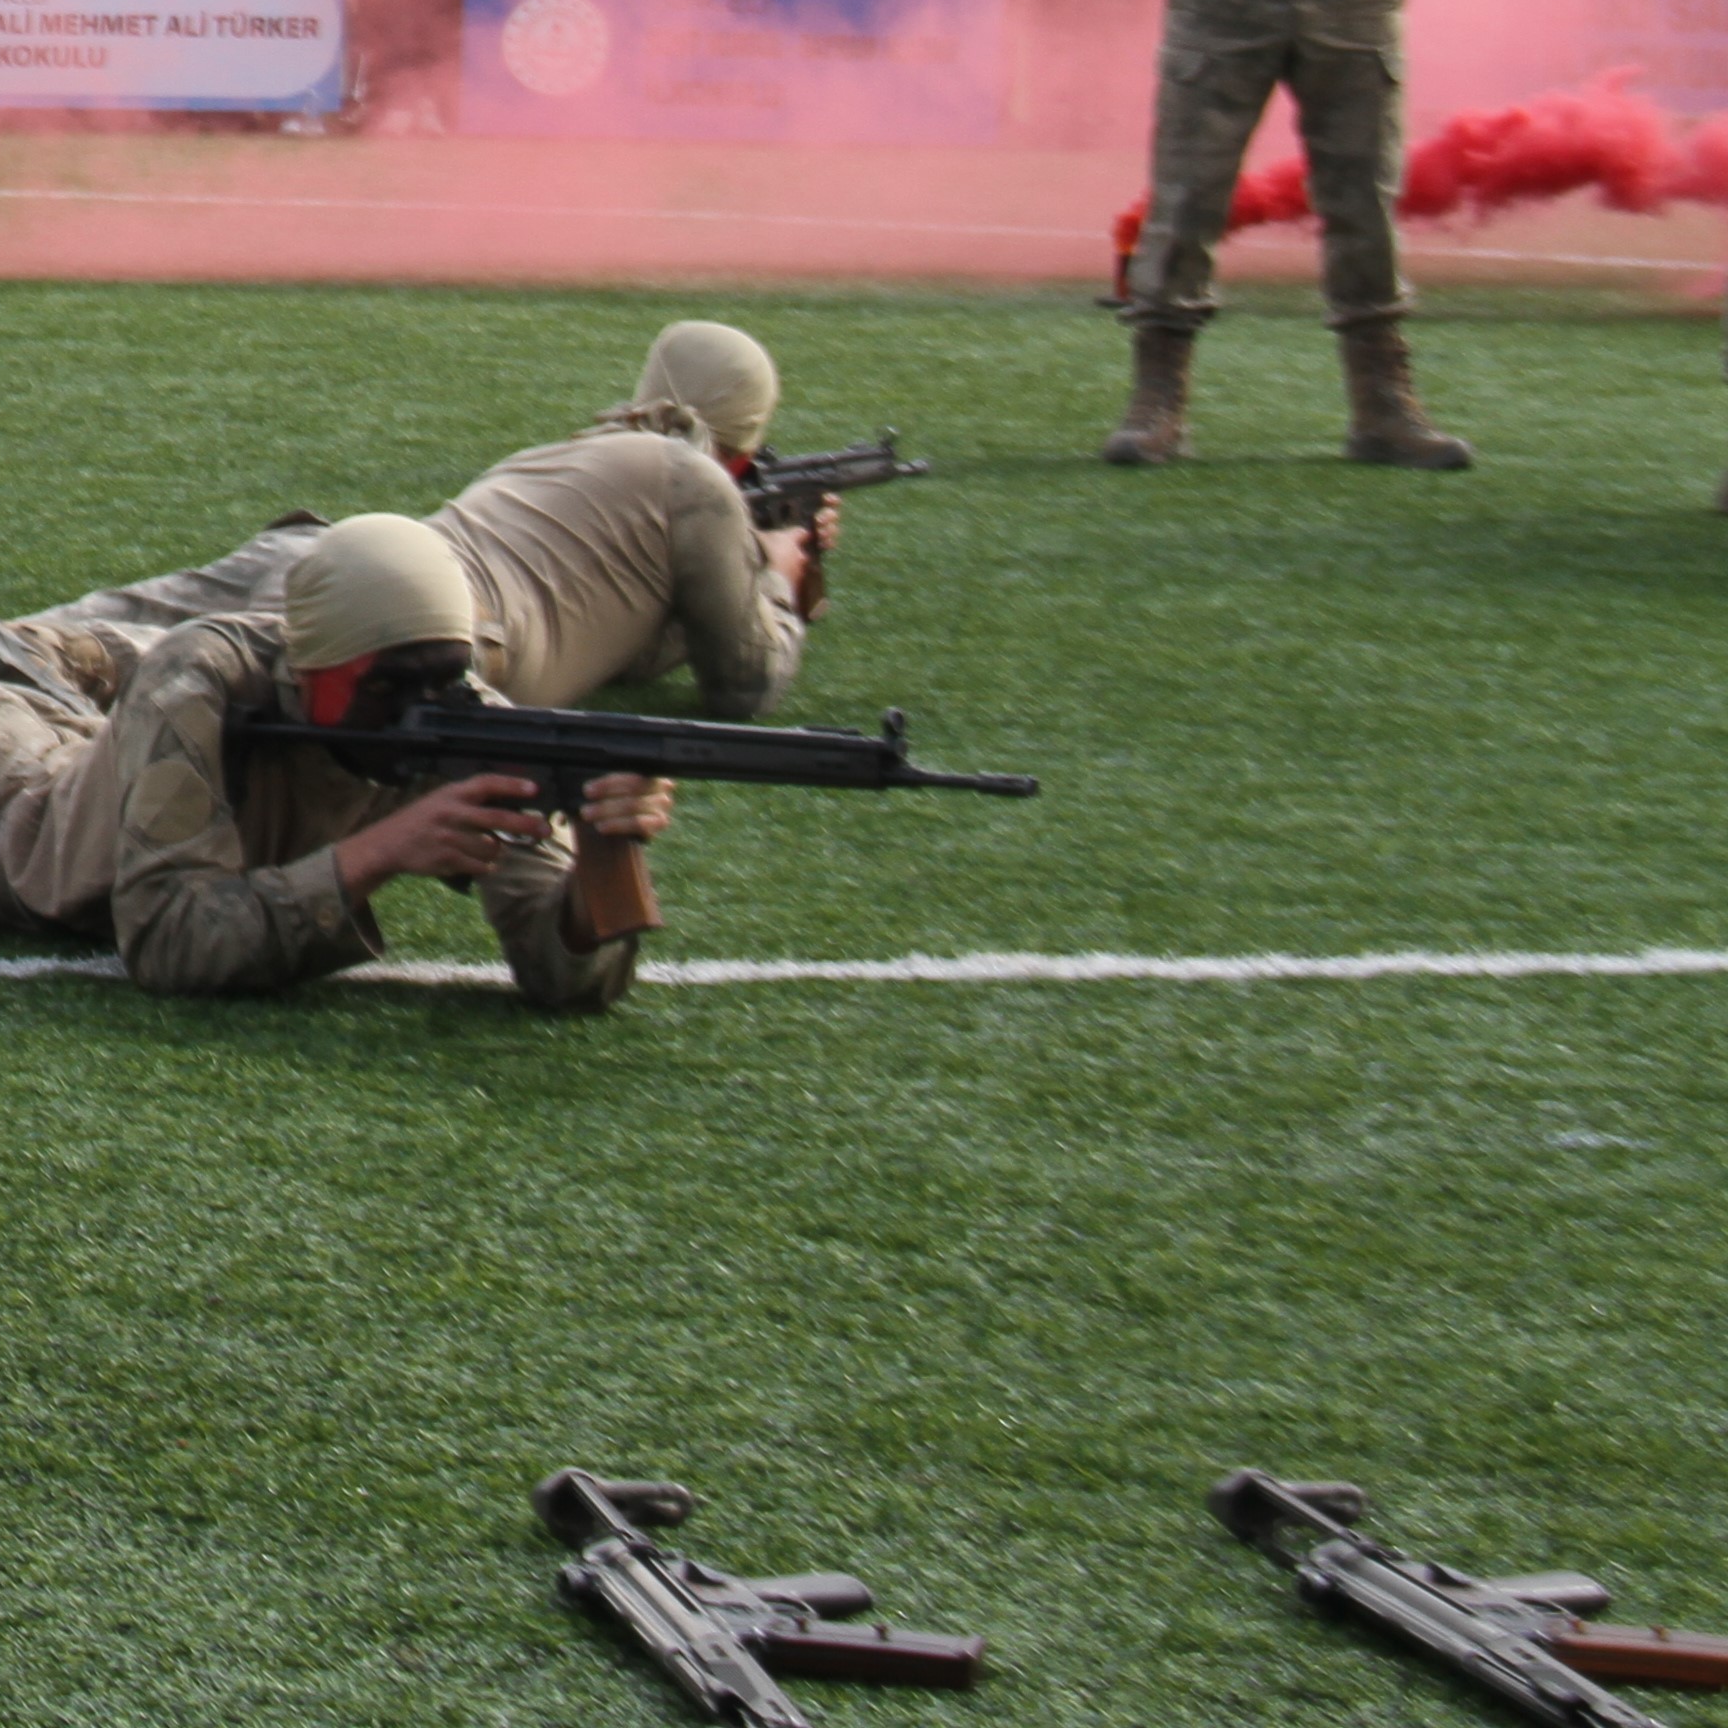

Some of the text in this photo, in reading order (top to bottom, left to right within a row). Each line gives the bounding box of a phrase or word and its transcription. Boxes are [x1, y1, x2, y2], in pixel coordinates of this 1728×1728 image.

[39, 11, 159, 37] MEHMET
[163, 11, 207, 38] ALİ
[211, 9, 321, 40] TÜRKER
